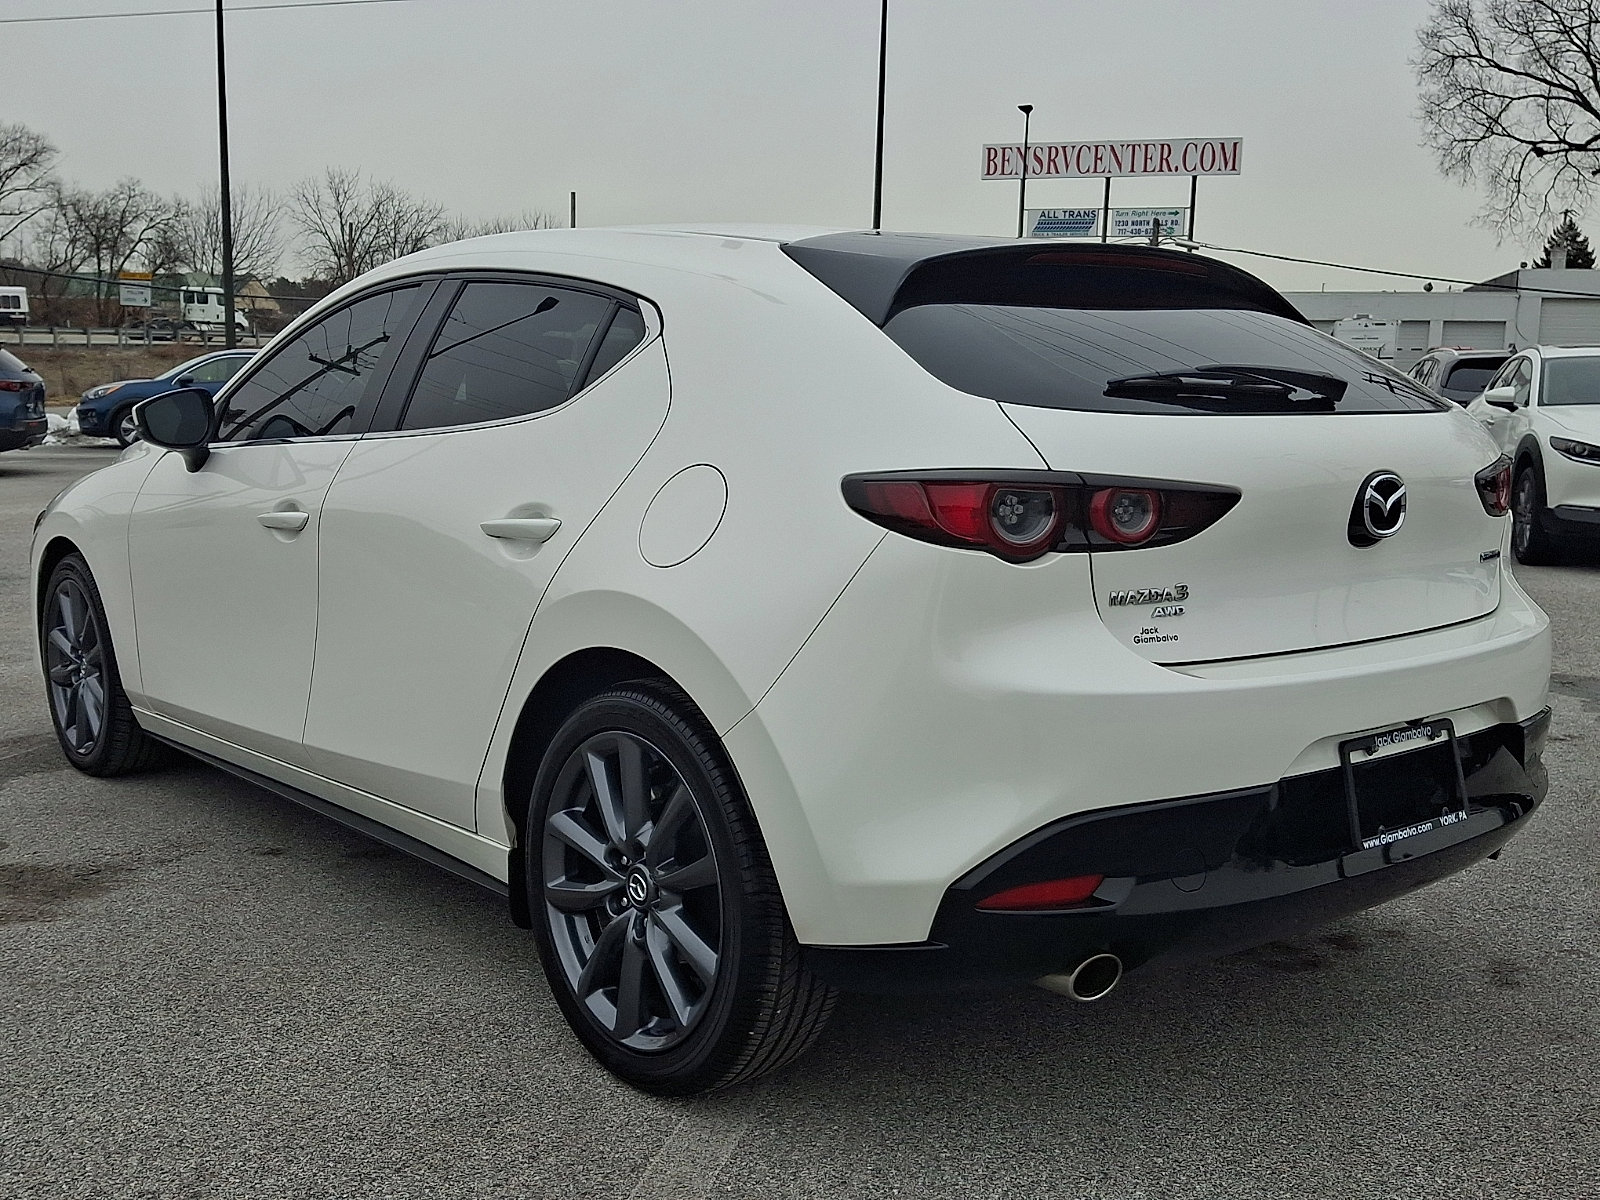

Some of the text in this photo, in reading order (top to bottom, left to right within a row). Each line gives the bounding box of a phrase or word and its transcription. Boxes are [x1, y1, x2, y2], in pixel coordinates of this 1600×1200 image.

[984, 141, 1240, 176] BENSRVCENTER.COM
[1039, 210, 1097, 219] ALL TRANS
[1131, 210, 1149, 218] Right
[1115, 219, 1129, 227] 1230
[1131, 219, 1150, 227] NORTH
[1151, 605, 1185, 618] AWD
[1140, 626, 1160, 635] Jack
[1133, 633, 1179, 644] Giambalvo
[1374, 726, 1432, 747] Jack Giambalvo
[1363, 822, 1433, 850] www.Giambalvo.com
[1458, 810, 1467, 821] PA
